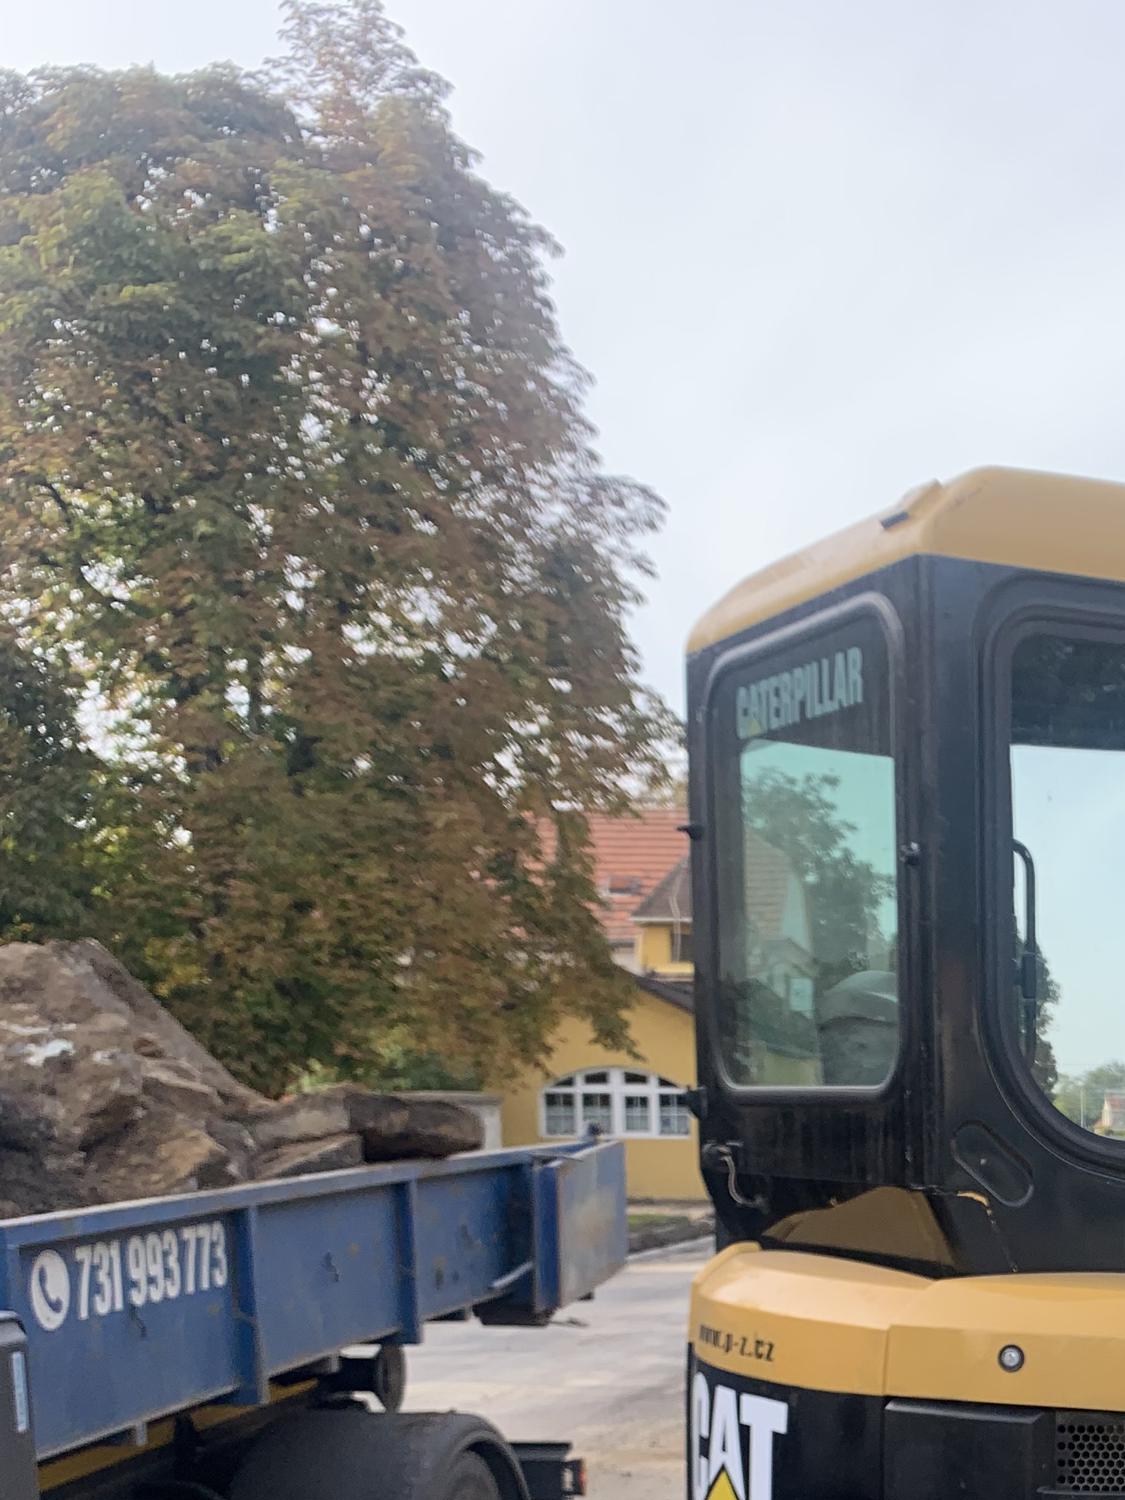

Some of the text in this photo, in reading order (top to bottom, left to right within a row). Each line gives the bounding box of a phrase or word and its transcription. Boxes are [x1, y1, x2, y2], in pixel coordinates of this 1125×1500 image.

[75, 1220, 229, 1321] 731 993 773
